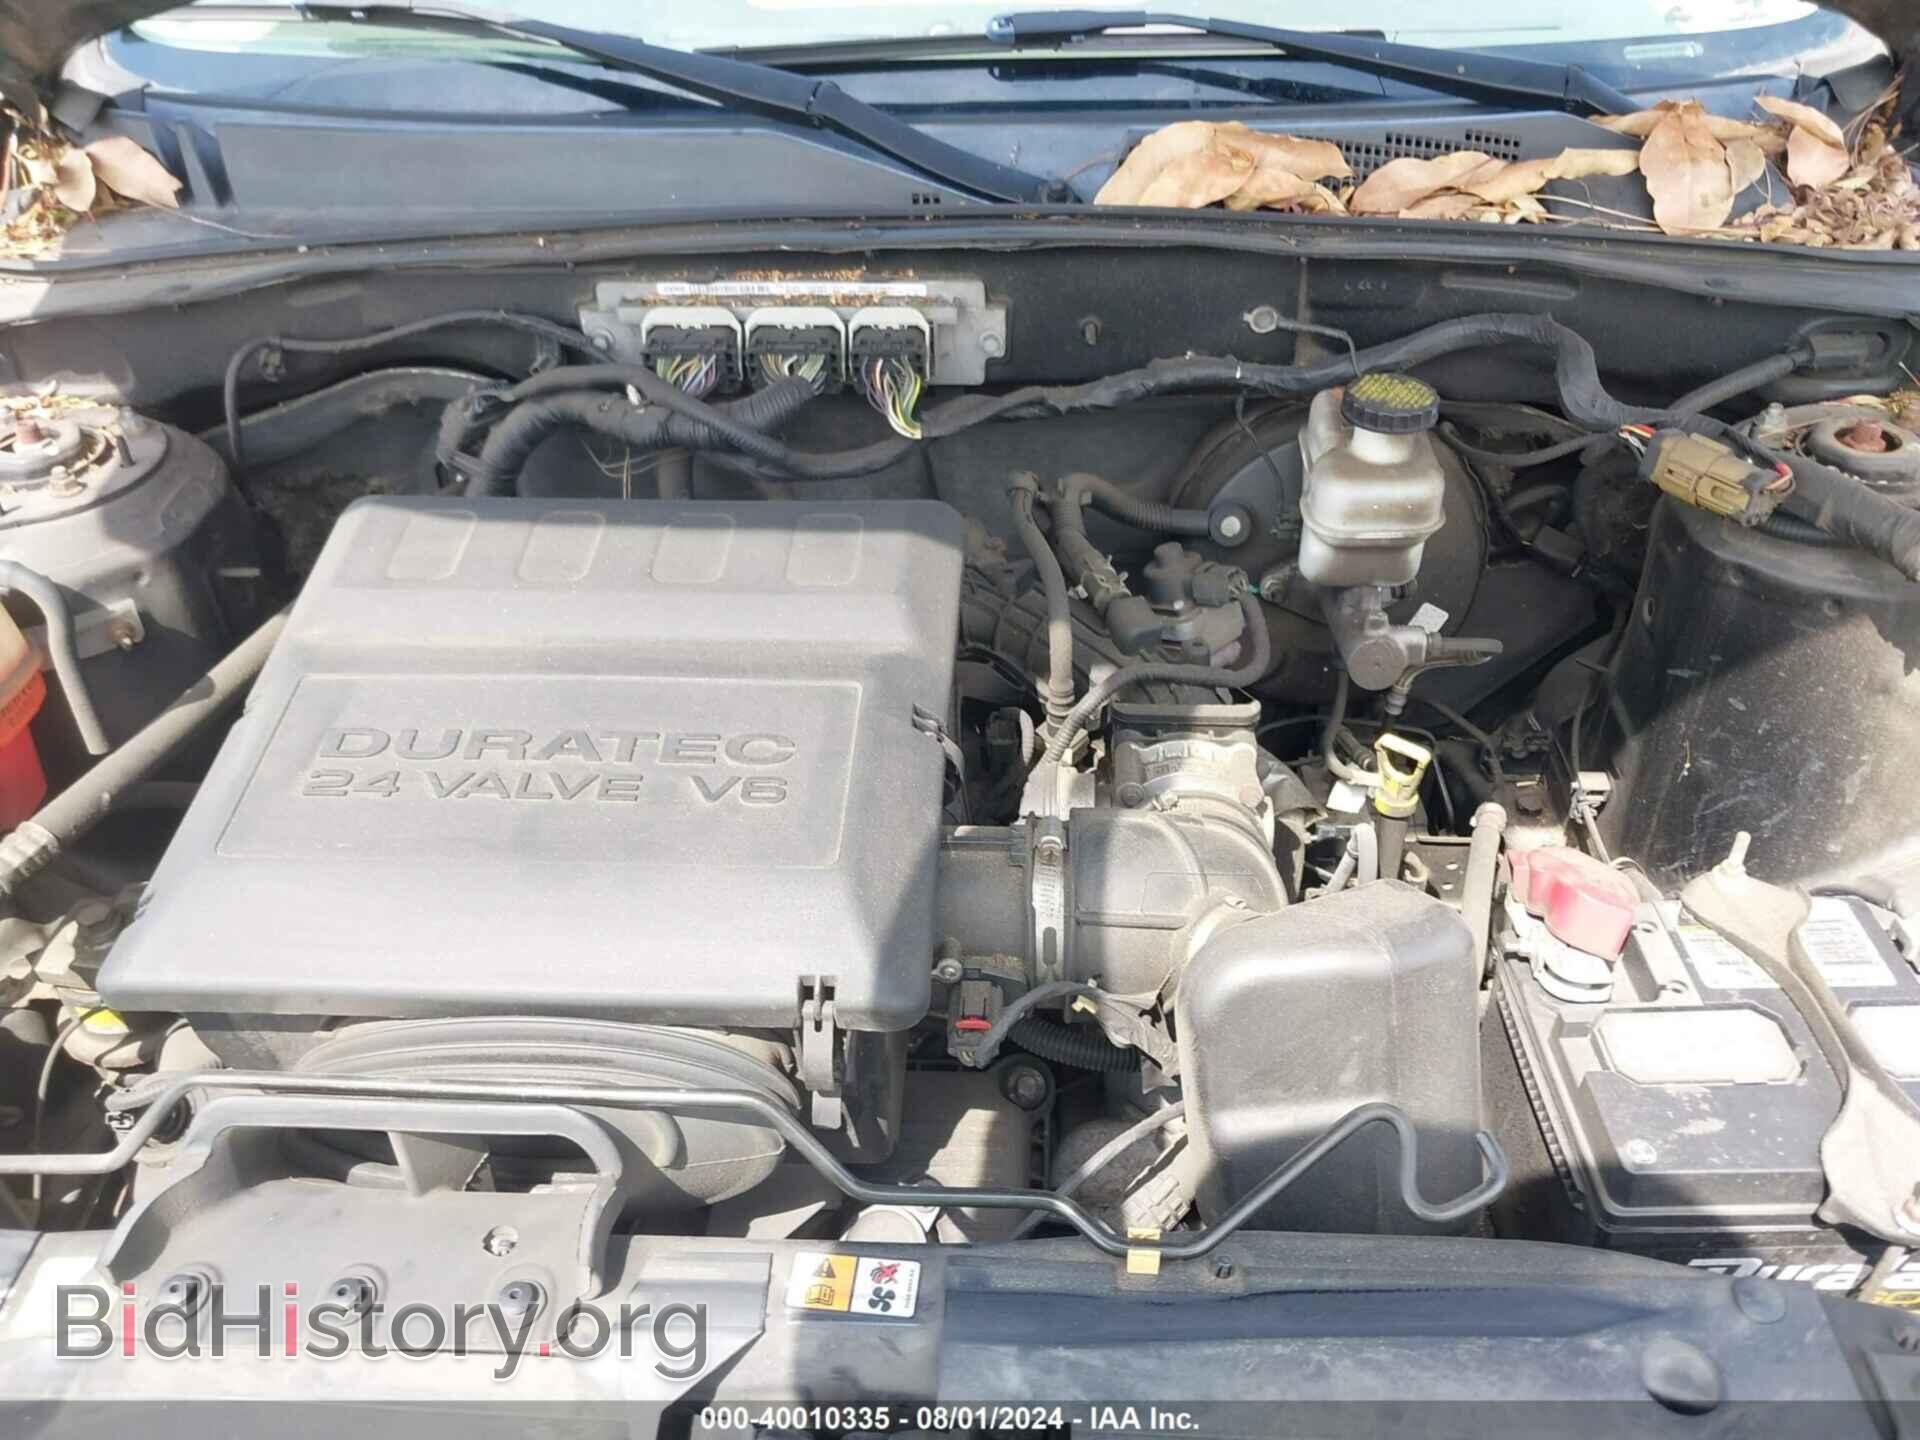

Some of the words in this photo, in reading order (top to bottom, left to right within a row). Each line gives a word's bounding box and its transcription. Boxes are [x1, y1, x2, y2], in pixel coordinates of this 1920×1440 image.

[317, 727, 797, 766] DURATEC
[301, 770, 401, 798] 24
[424, 772, 644, 802] VALVE
[691, 775, 789, 805] V6
